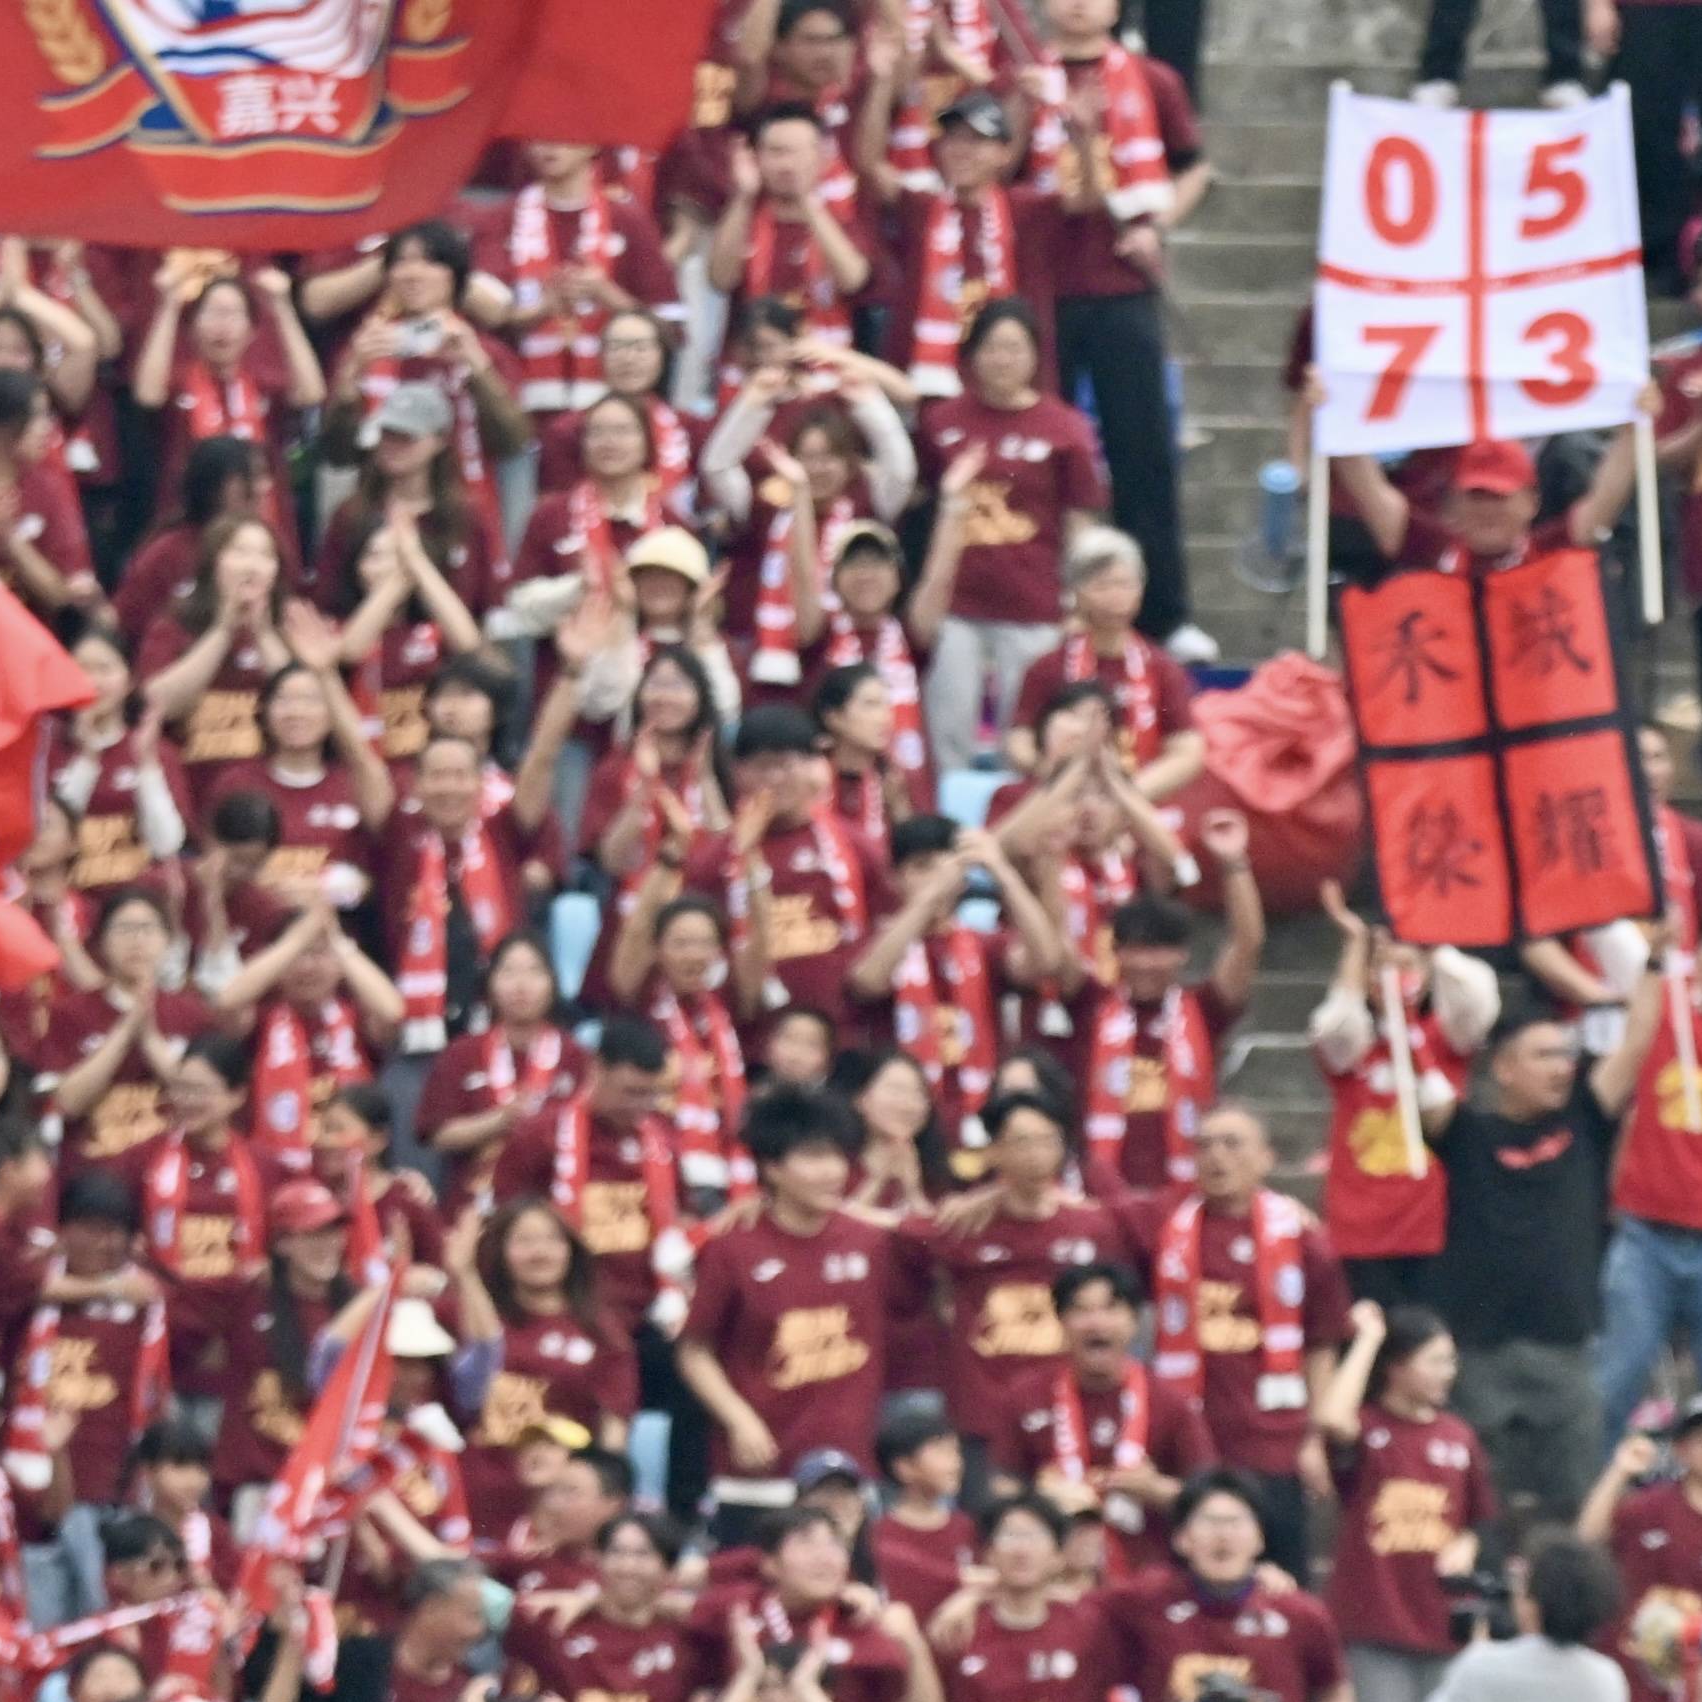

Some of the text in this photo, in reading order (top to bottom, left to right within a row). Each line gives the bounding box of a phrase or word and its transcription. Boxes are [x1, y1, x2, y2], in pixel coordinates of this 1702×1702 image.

[218, 74, 342, 136] 嘉兴
[1364, 136, 1588, 246] 0 5
[1362, 311, 1596, 421] 7 3
